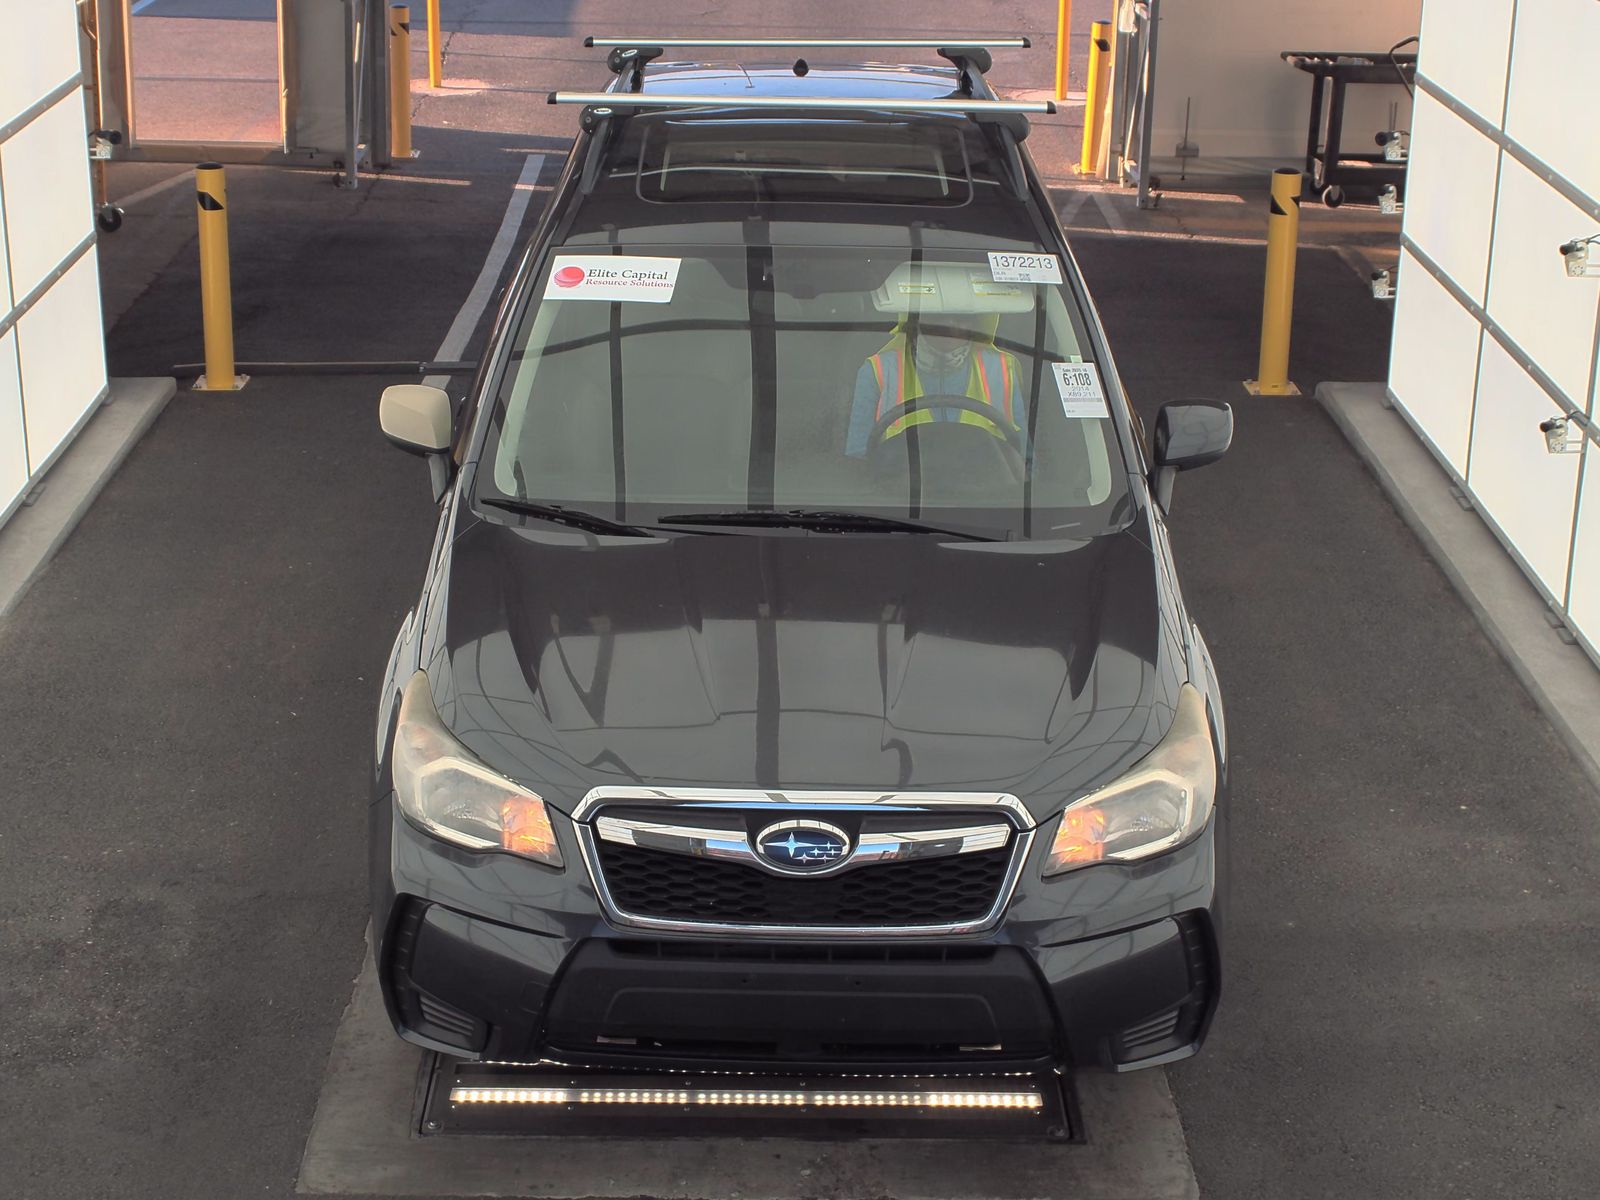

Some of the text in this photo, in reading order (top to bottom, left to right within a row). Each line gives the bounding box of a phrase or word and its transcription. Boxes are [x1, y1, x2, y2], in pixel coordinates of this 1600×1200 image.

[992, 255, 1053, 269] 1372213
[588, 268, 668, 281] Elite Capital
[585, 278, 674, 289] Resource Solutions
[1062, 372, 1092, 386] 6:108
